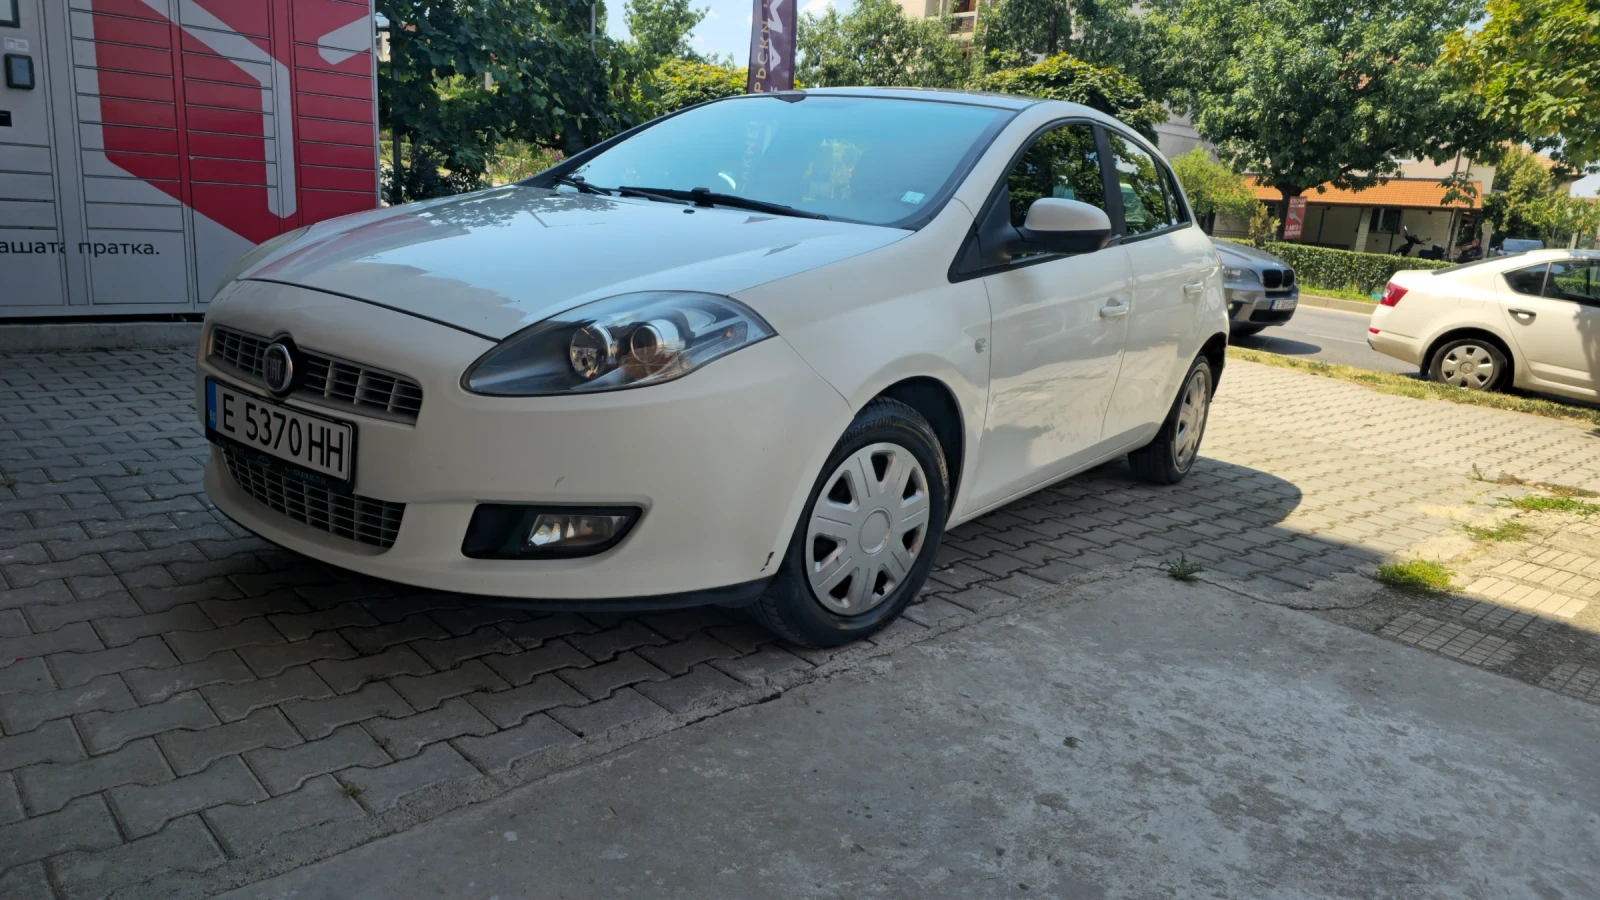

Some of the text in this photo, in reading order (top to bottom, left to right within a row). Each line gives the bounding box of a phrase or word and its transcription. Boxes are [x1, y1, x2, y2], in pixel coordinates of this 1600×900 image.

[78, 242, 160, 257] пратка.
[222, 393, 343, 472] E 5370 HH
